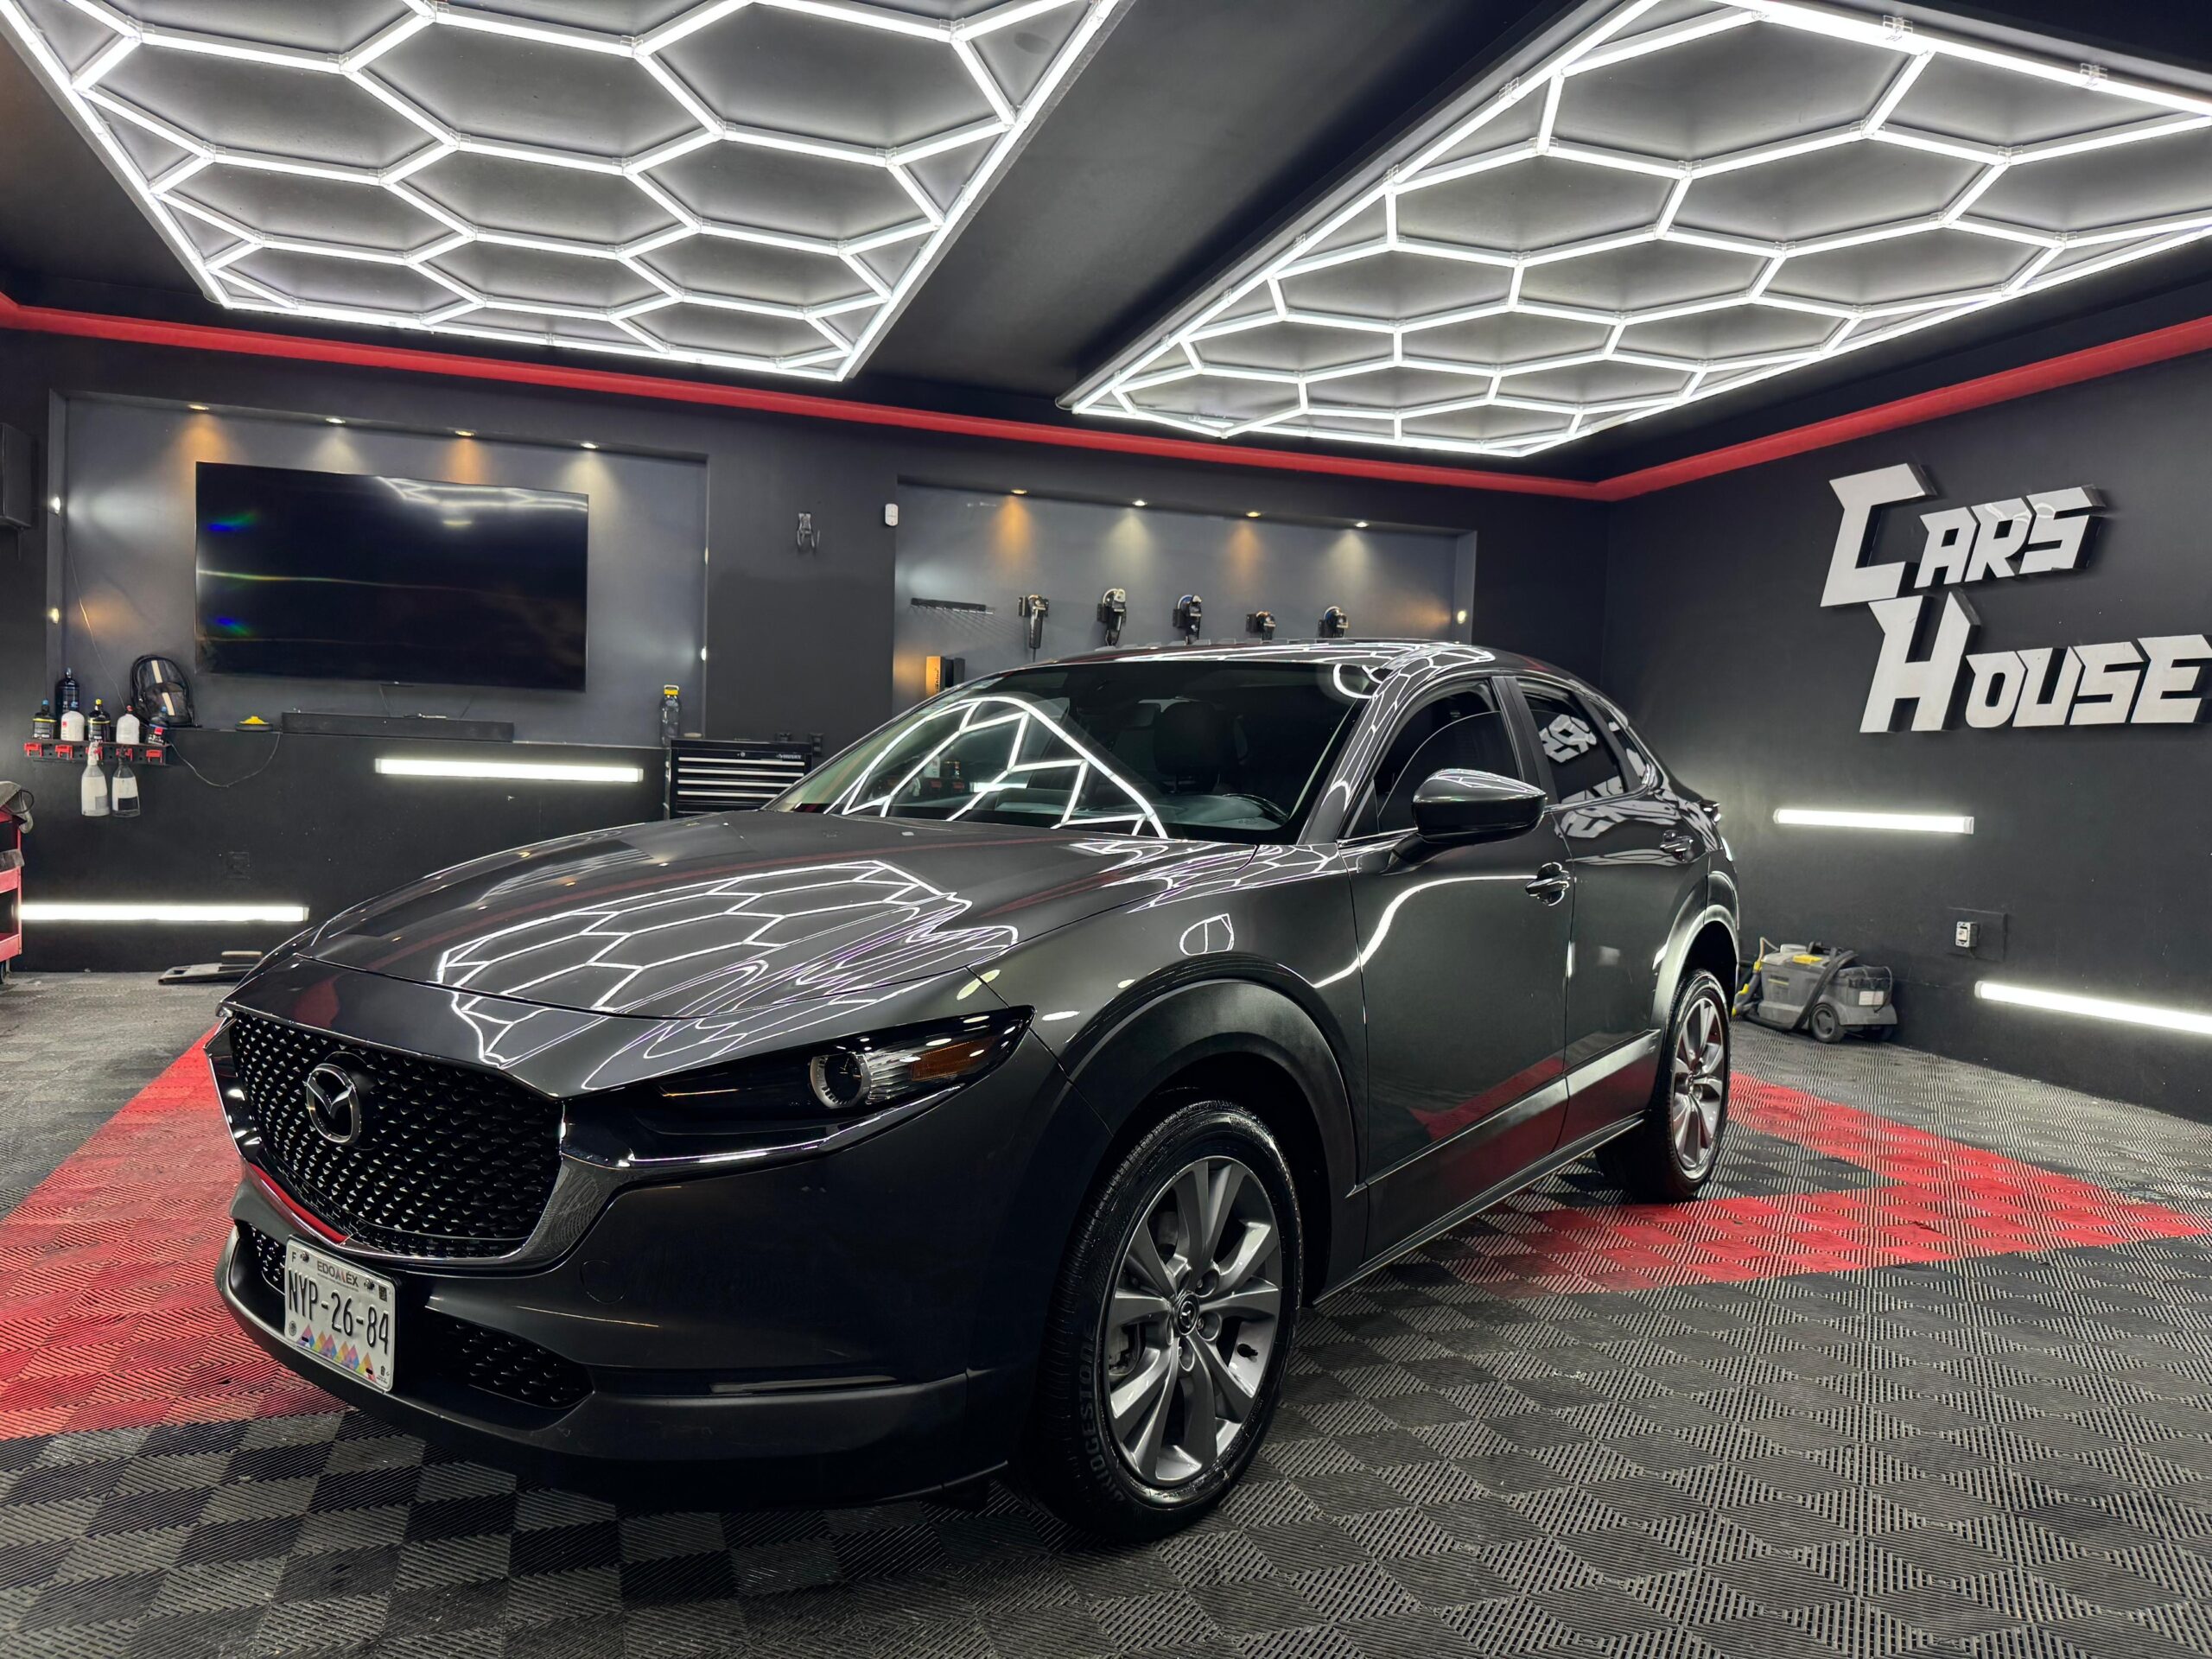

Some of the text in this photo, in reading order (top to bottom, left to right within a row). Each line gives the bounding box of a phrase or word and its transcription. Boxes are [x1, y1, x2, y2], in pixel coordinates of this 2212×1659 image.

[1821, 463, 2096, 607] CARS
[1859, 591, 2212, 733] HOUSE
[288, 1268, 389, 1355] NYP-26-84
